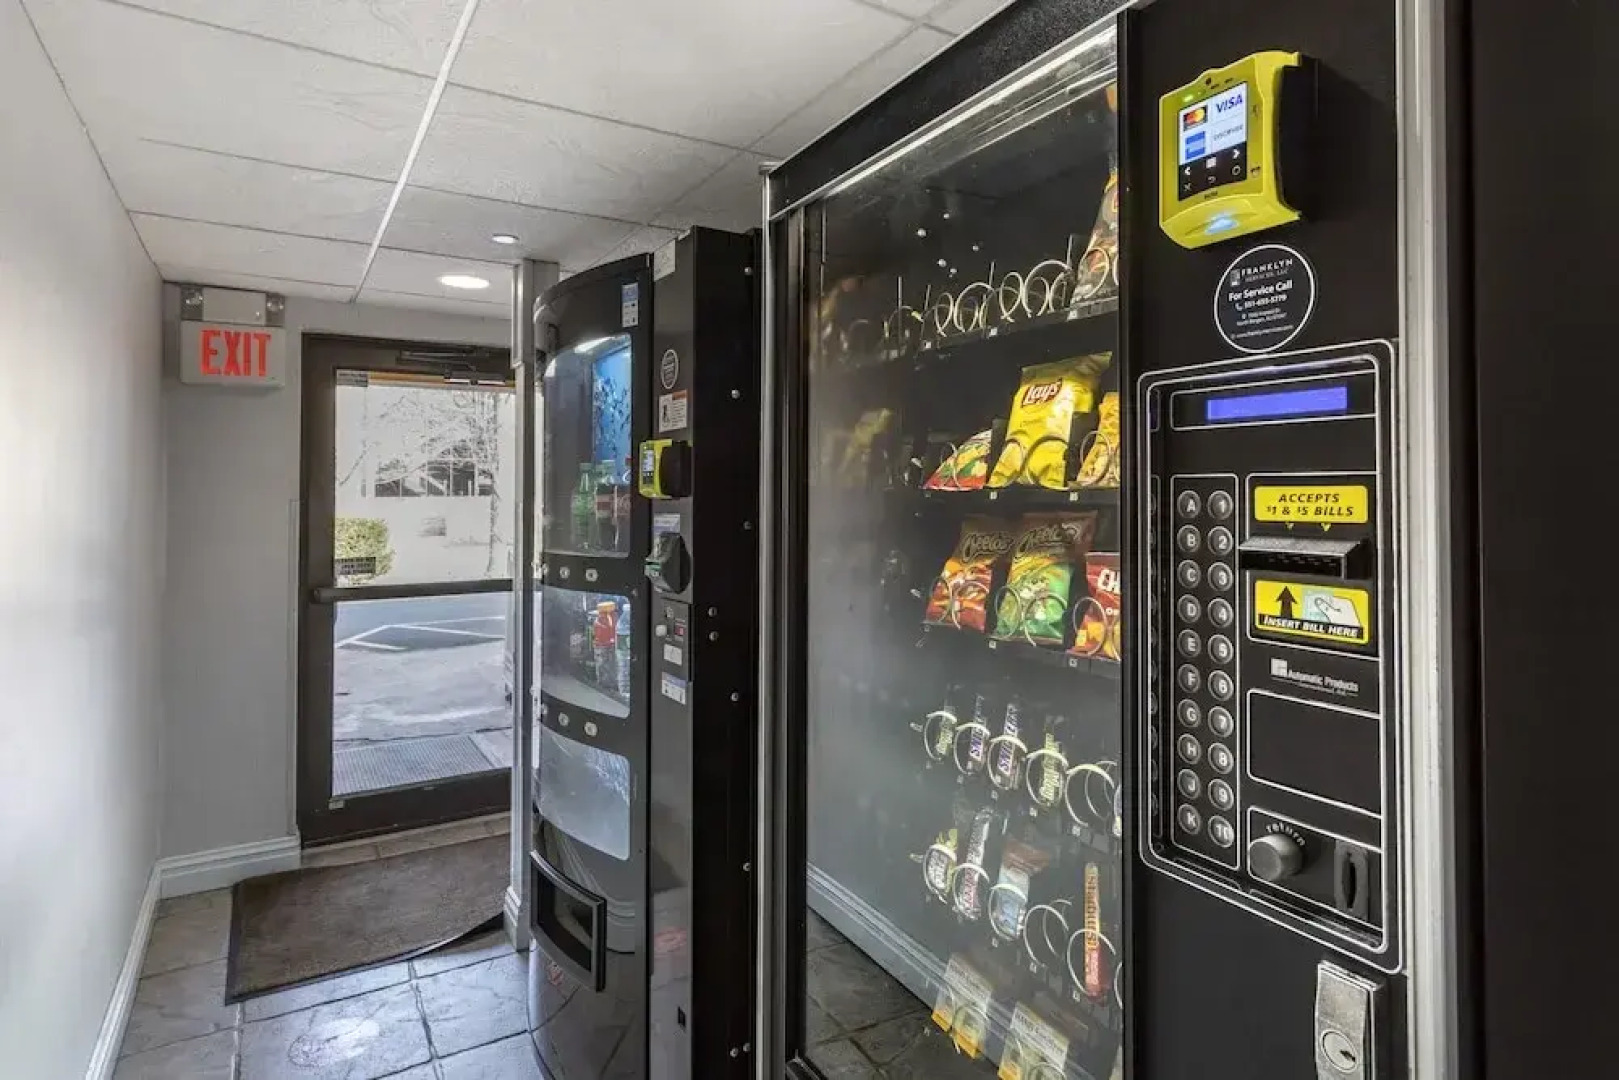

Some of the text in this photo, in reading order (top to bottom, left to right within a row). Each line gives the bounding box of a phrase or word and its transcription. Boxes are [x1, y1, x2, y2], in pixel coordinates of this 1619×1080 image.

[1215, 93, 1243, 113] VISA
[1241, 259, 1293, 277] FRANKLYN
[1228, 280, 1293, 302] For Service Call
[201, 329, 272, 376] EXIT
[1278, 493, 1341, 503] ACCEPTS
[1281, 506, 1290, 516] &
[1314, 506, 1355, 516] BILLS
[1263, 614, 1359, 637] INSERT BILL HERE
